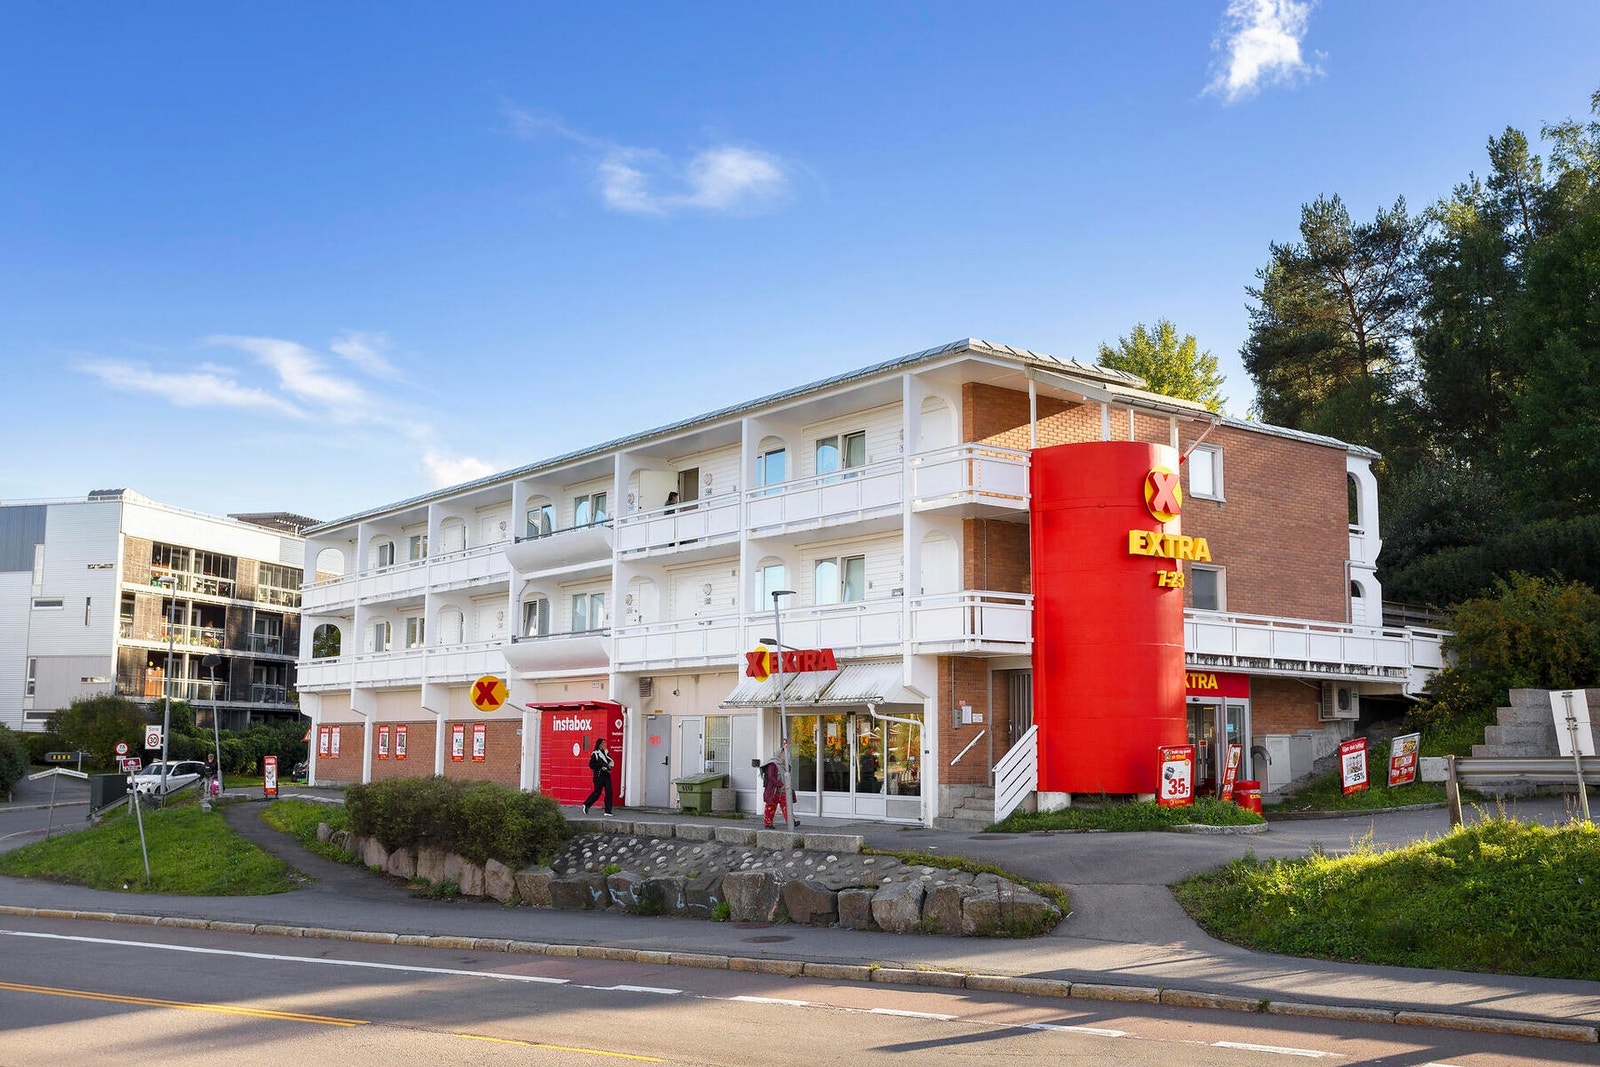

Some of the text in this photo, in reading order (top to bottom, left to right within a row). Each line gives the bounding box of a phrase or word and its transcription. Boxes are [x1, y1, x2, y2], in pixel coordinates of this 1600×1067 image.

[1148, 472, 1181, 514] X
[1129, 529, 1212, 562] EXTRA
[746, 648, 838, 677] X EXTRA
[475, 681, 499, 705] X
[1185, 672, 1219, 690] XTRA
[552, 714, 593, 732] instabox
[149, 736, 157, 744] 30
